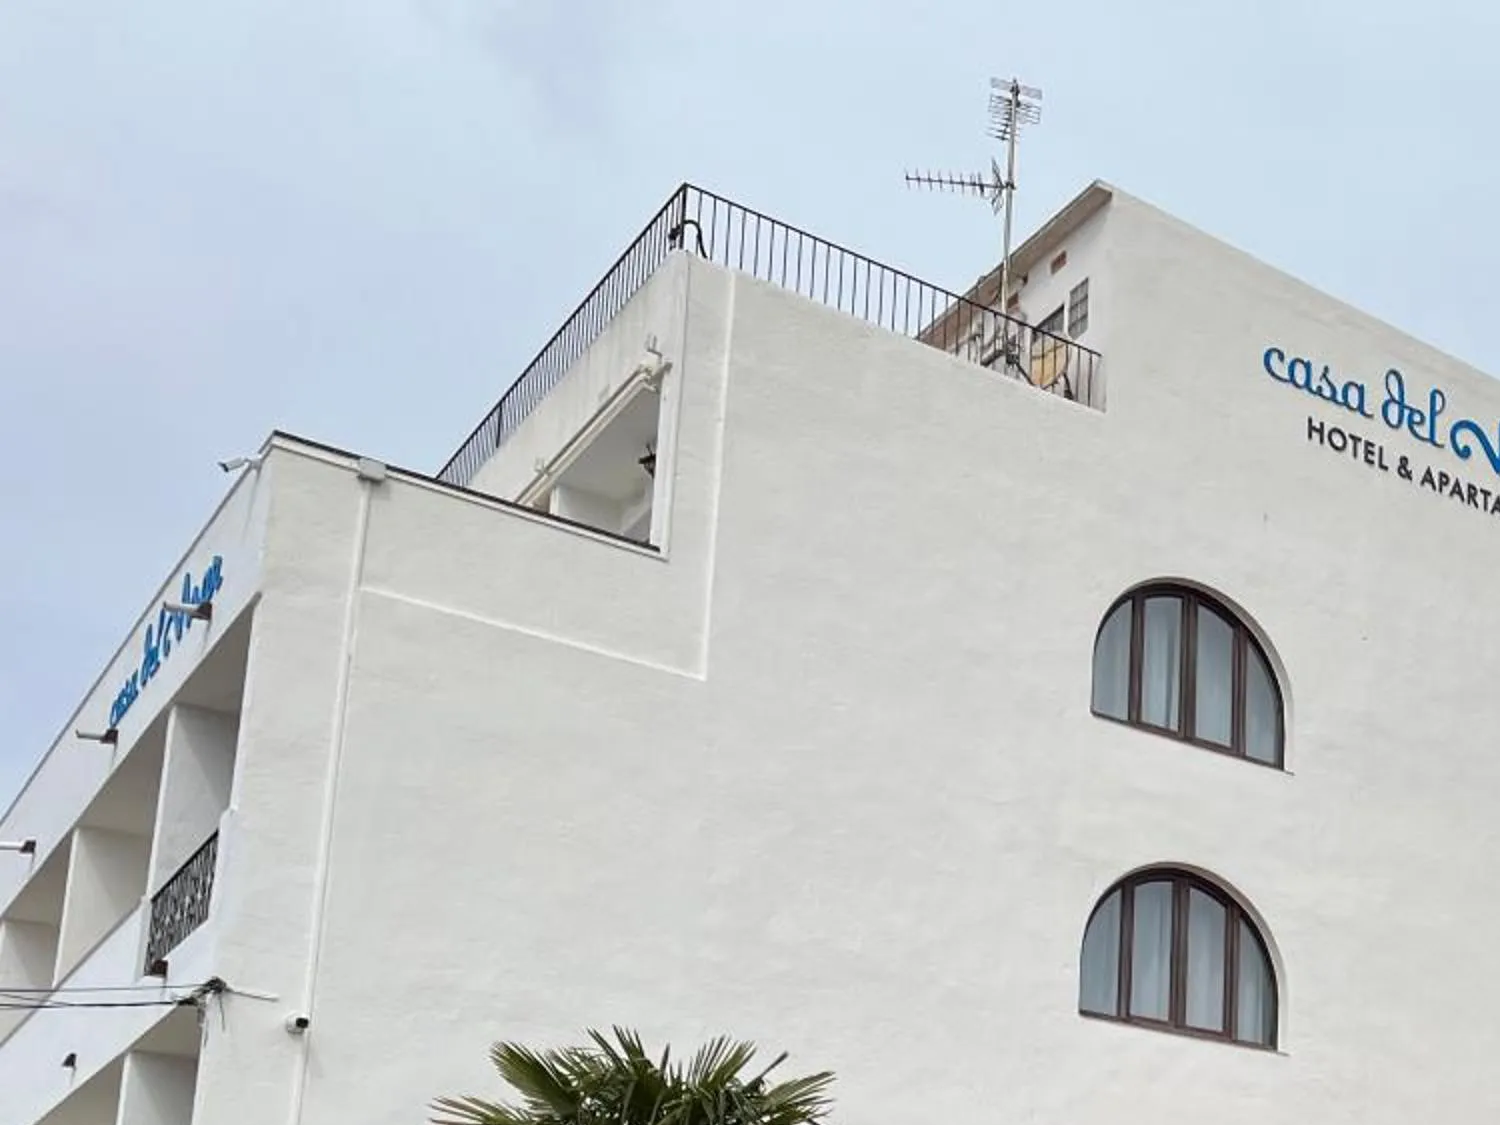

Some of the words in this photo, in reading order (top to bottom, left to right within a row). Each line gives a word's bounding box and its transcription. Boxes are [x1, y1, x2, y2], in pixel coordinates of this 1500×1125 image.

[1262, 347, 1374, 419] casa
[1380, 369, 1446, 449] del
[1307, 416, 1389, 472] HOTEL
[1397, 455, 1413, 482] &
